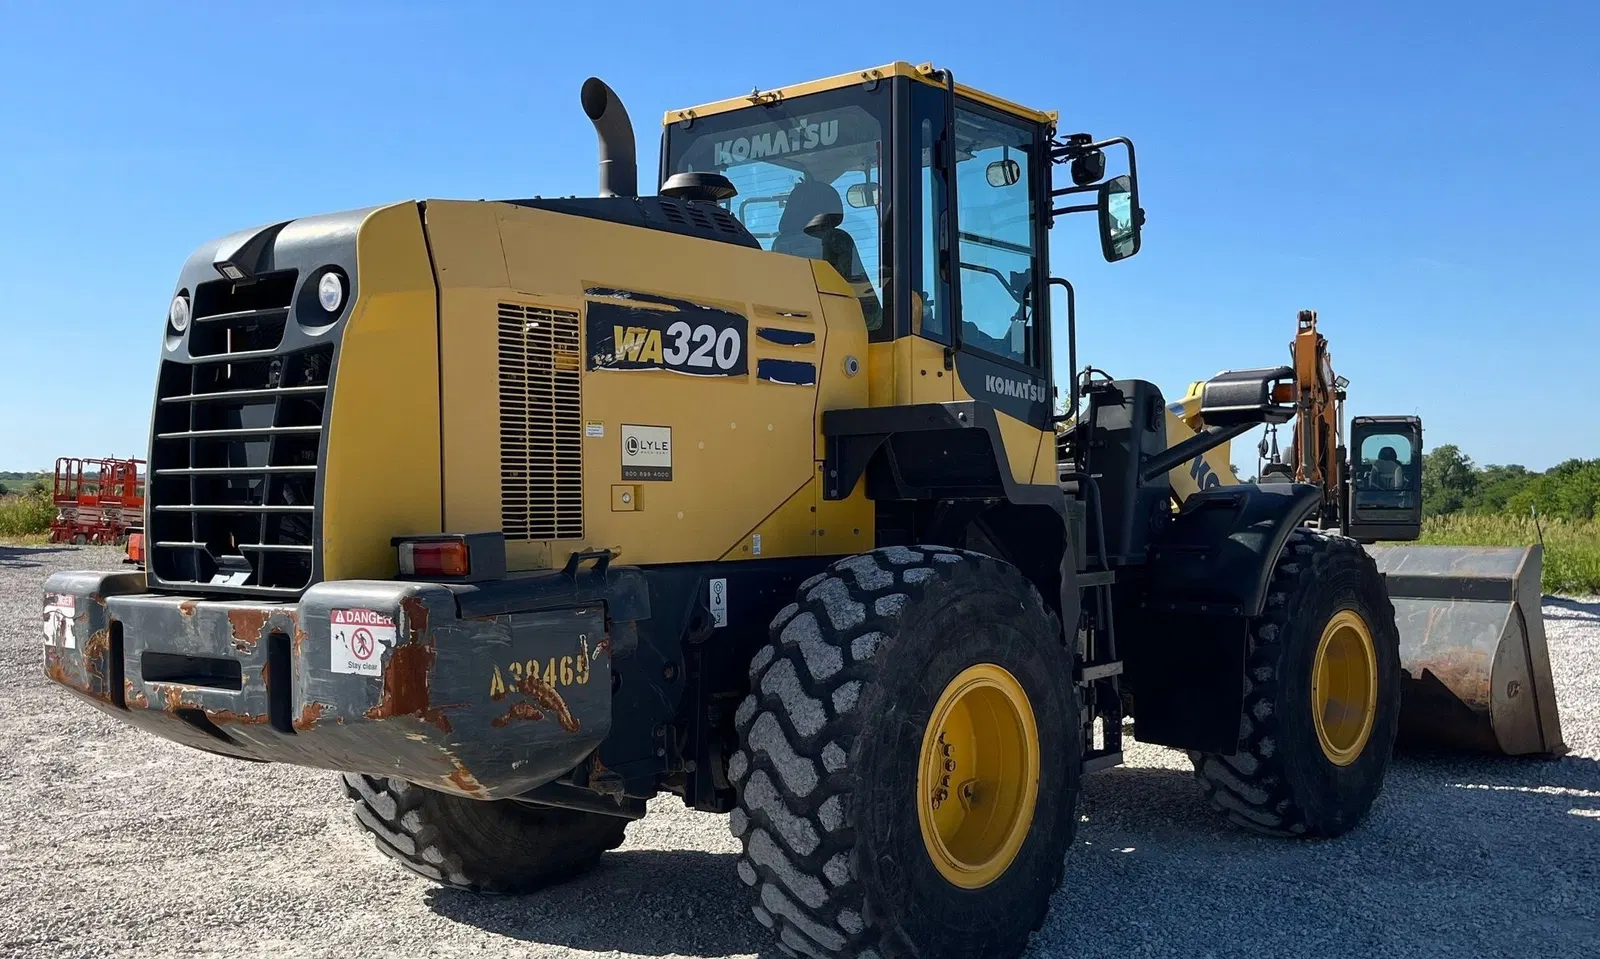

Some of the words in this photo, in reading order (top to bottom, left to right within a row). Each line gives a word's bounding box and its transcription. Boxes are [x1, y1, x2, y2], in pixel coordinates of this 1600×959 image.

[714, 119, 839, 166] KOMATSU
[613, 321, 741, 370] WA320
[985, 374, 1046, 403] KOMATSU
[640, 440, 669, 450] LYLE
[347, 660, 361, 671] Stay
[362, 662, 378, 670] clear
